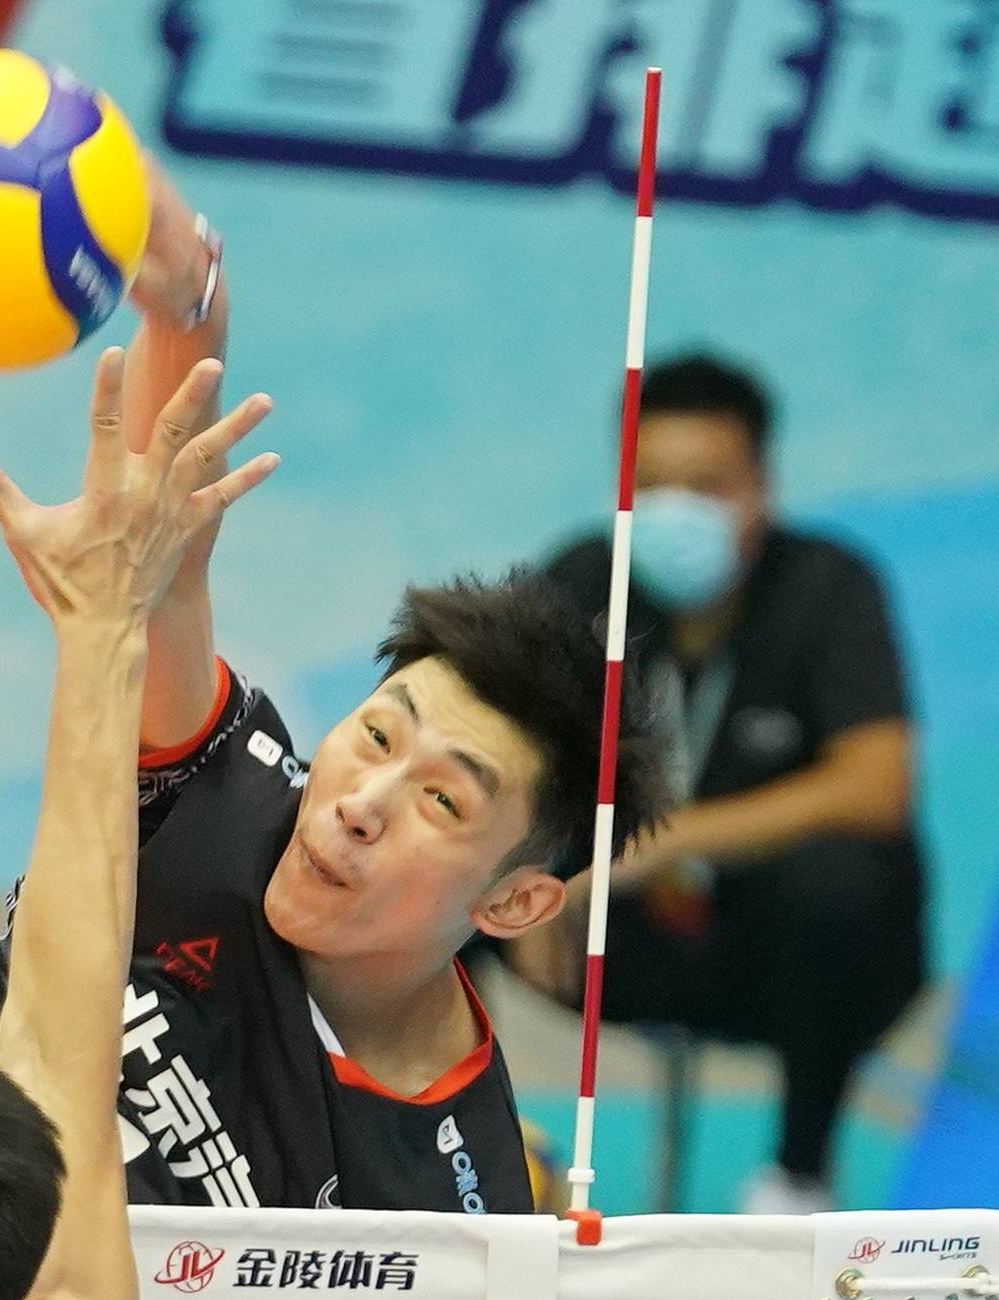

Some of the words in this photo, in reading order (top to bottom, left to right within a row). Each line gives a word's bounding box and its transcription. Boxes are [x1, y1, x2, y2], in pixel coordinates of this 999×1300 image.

[891, 1236, 981, 1254] JINLING
[232, 1248, 419, 1290] 金陵体育
